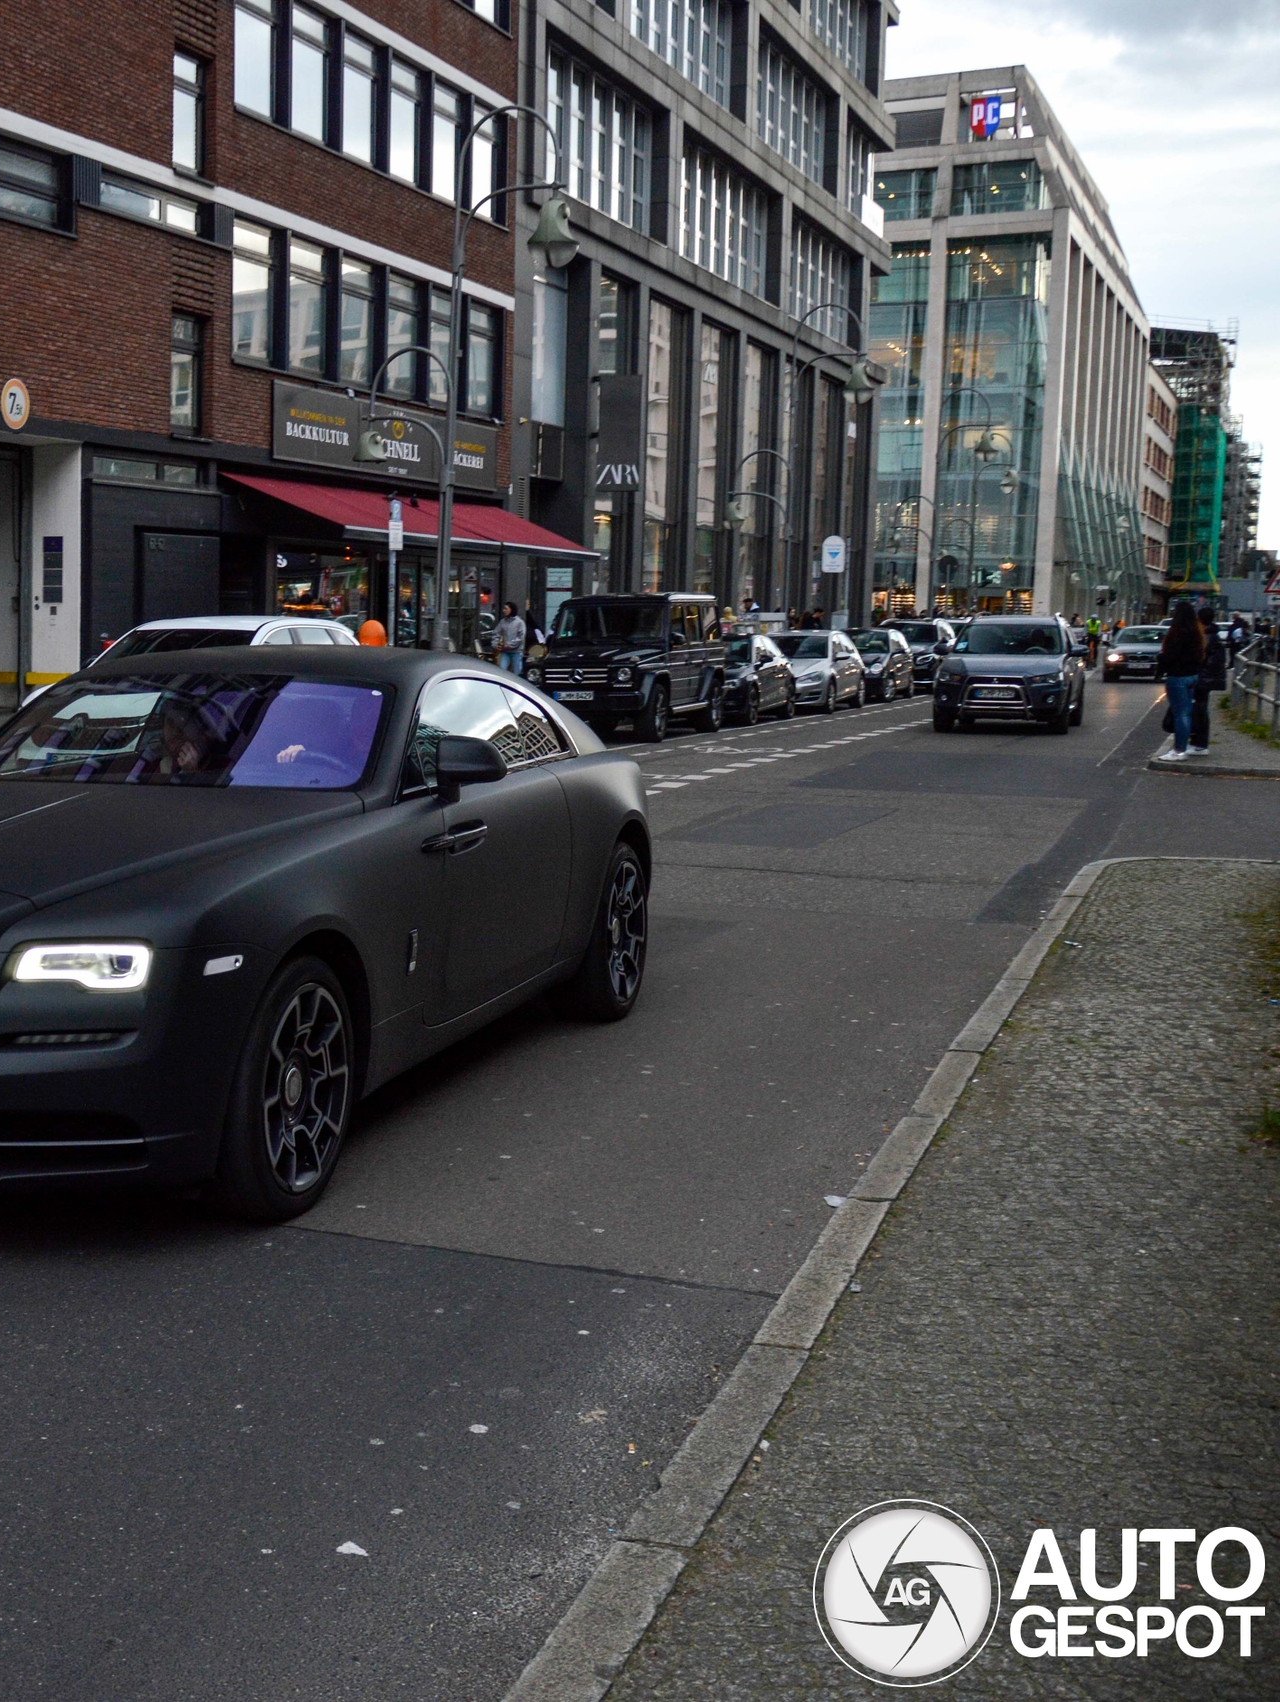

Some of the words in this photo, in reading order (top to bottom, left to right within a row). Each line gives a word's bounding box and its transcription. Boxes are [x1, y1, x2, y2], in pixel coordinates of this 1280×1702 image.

[286, 421, 350, 447] BACKKULTUR
[381, 438, 421, 462] CHNELL
[453, 450, 484, 470] ÄCKEREI
[596, 463, 640, 485] ZARA
